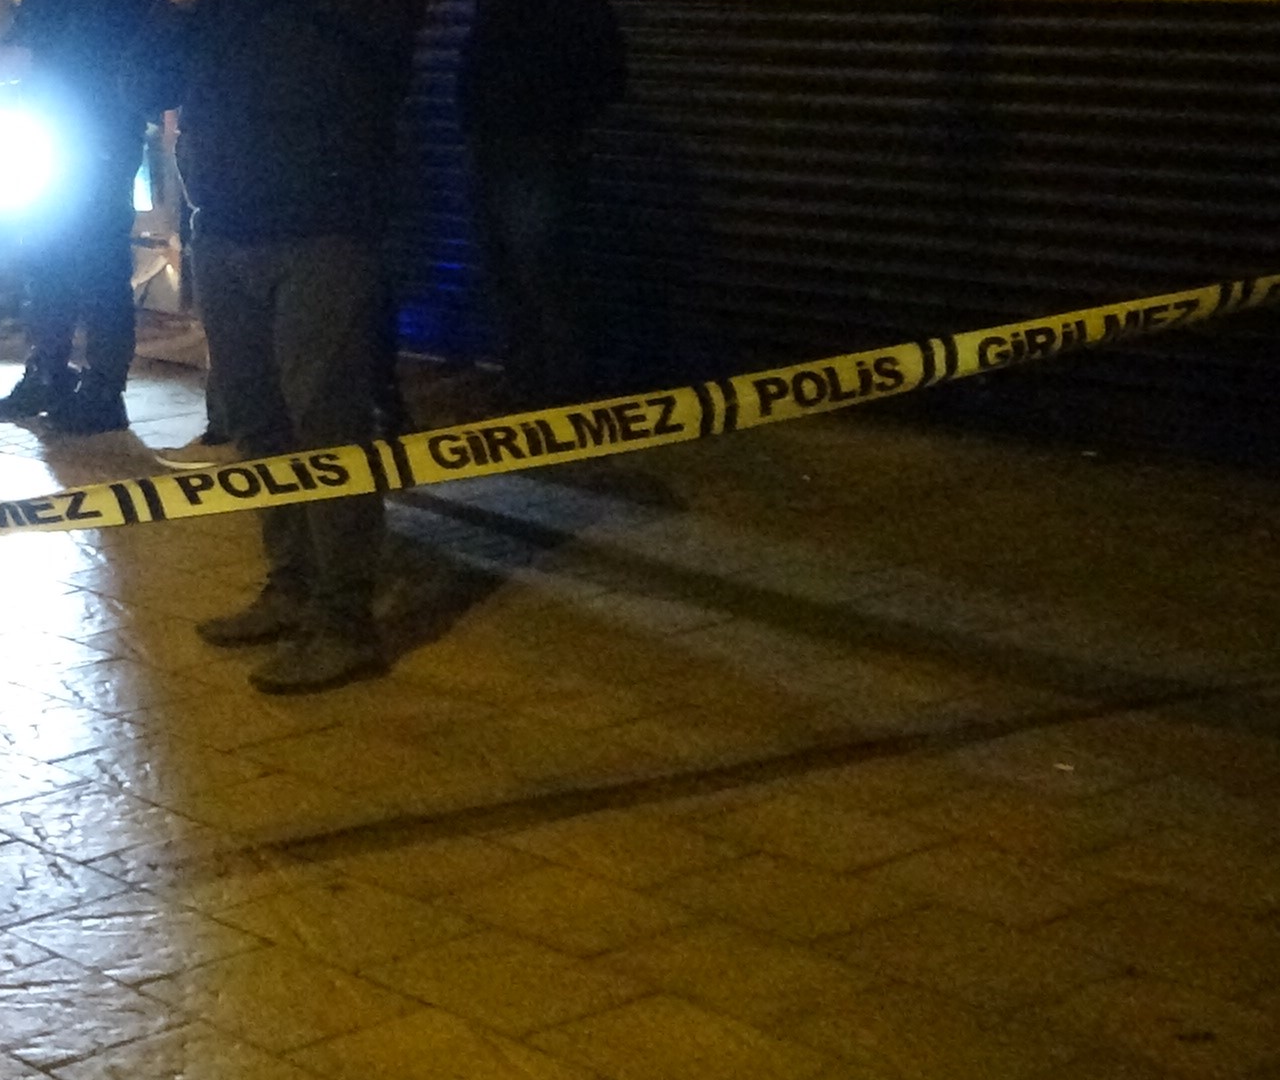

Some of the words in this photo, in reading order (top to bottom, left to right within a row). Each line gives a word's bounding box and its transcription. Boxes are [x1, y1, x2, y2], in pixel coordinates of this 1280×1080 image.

[753, 355, 905, 417] POLİS
[428, 395, 685, 472] GİRİLMEZ
[176, 450, 349, 506] POLİS
